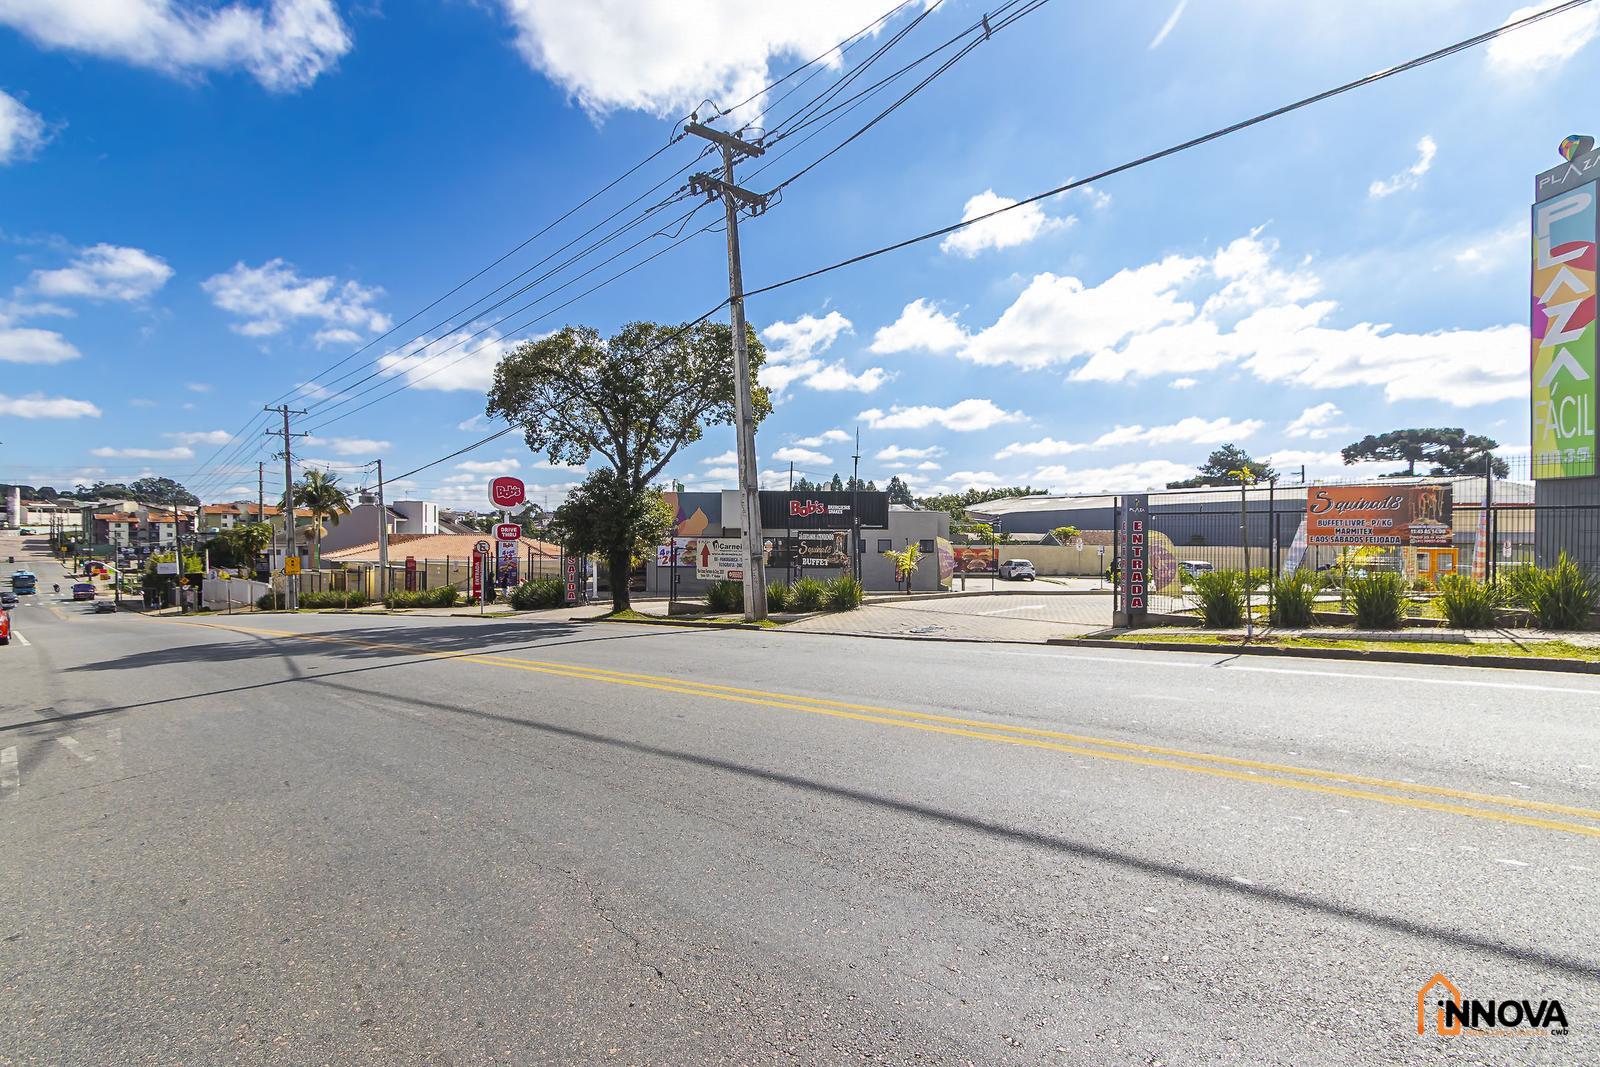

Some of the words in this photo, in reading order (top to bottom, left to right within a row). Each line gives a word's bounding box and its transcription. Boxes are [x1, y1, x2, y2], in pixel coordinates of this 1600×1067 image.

[1537, 192, 1592, 388] PLAZA
[1533, 382, 1595, 440] FÁCIL
[496, 485, 521, 499] Bob's
[789, 499, 825, 518] Bob's
[1317, 519, 1344, 527] BUFFET
[1344, 519, 1366, 527] LIVRE
[1381, 519, 1393, 527] KG
[1334, 528, 1374, 536] MARMITEX
[1365, 536, 1402, 544] FEIJOADA
[802, 557, 829, 567] BUFFET
[1131, 521, 1144, 608] ENTRADA
